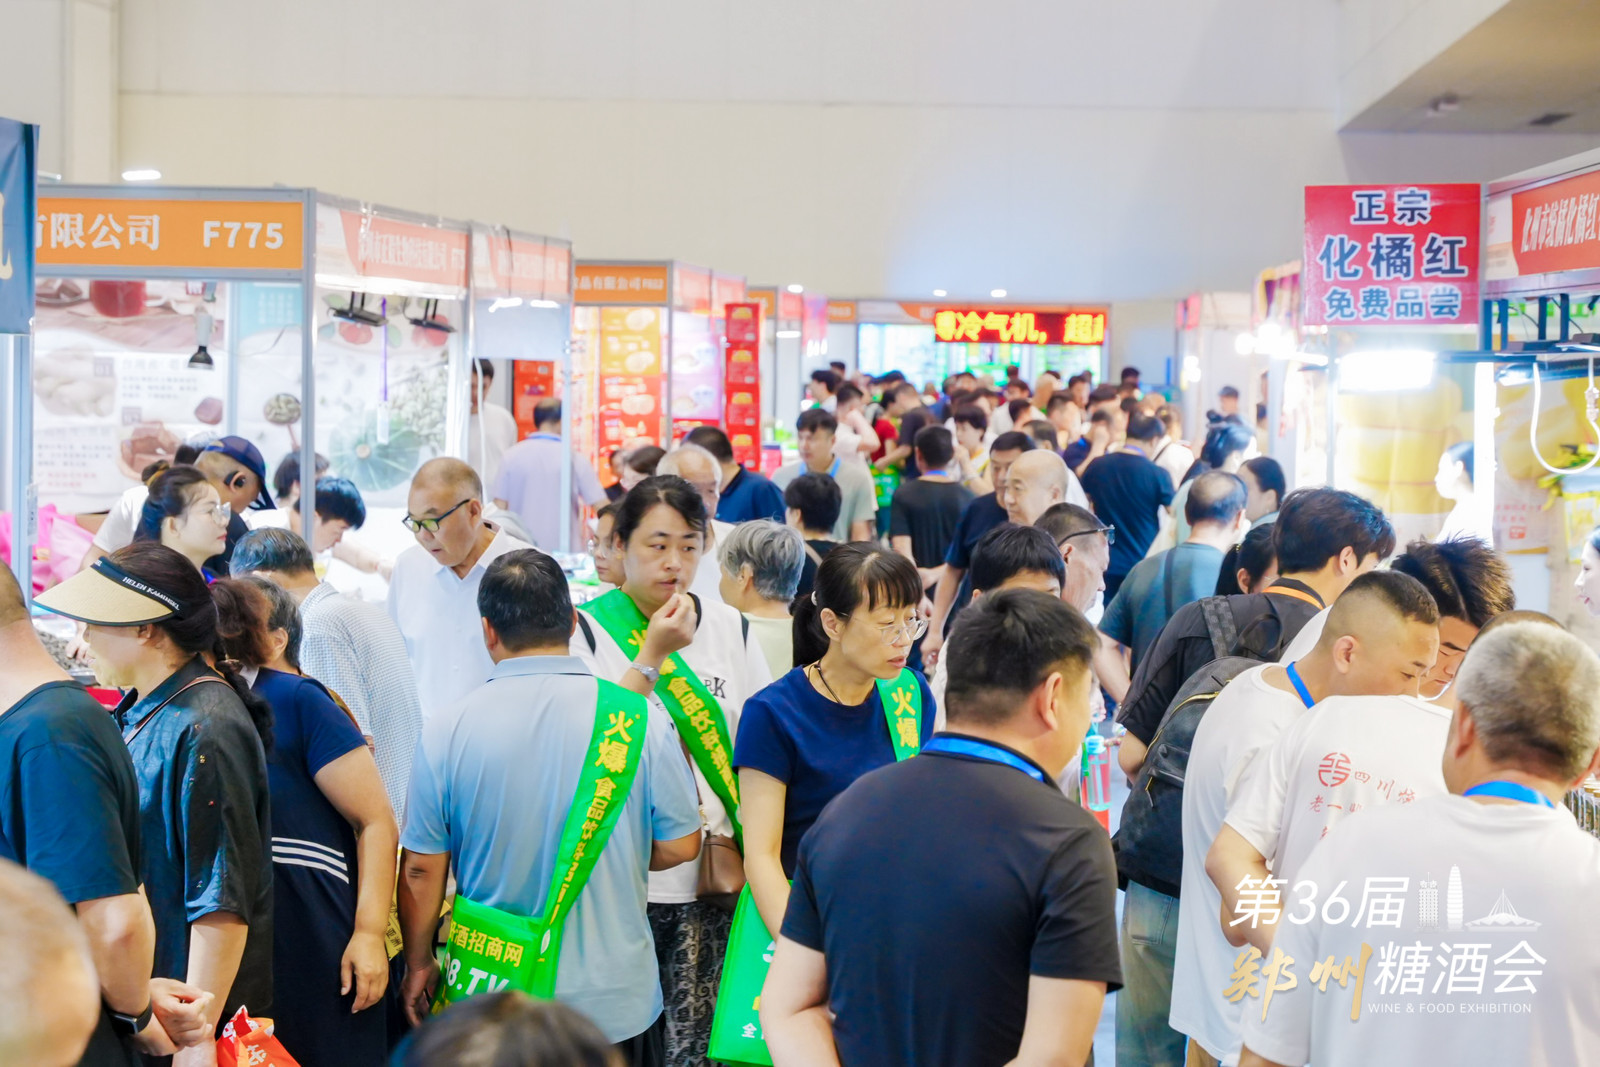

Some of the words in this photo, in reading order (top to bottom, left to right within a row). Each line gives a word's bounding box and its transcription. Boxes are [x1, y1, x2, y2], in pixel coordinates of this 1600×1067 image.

[1351, 187, 1434, 225] 正宗
[203, 221, 284, 249] F775
[1318, 233, 1467, 281] 化橘红
[1324, 286, 1461, 320] 免费品尝
[122, 576, 147, 591] HELEN
[891, 687, 919, 749] 火爆
[594, 710, 634, 773] 火爆
